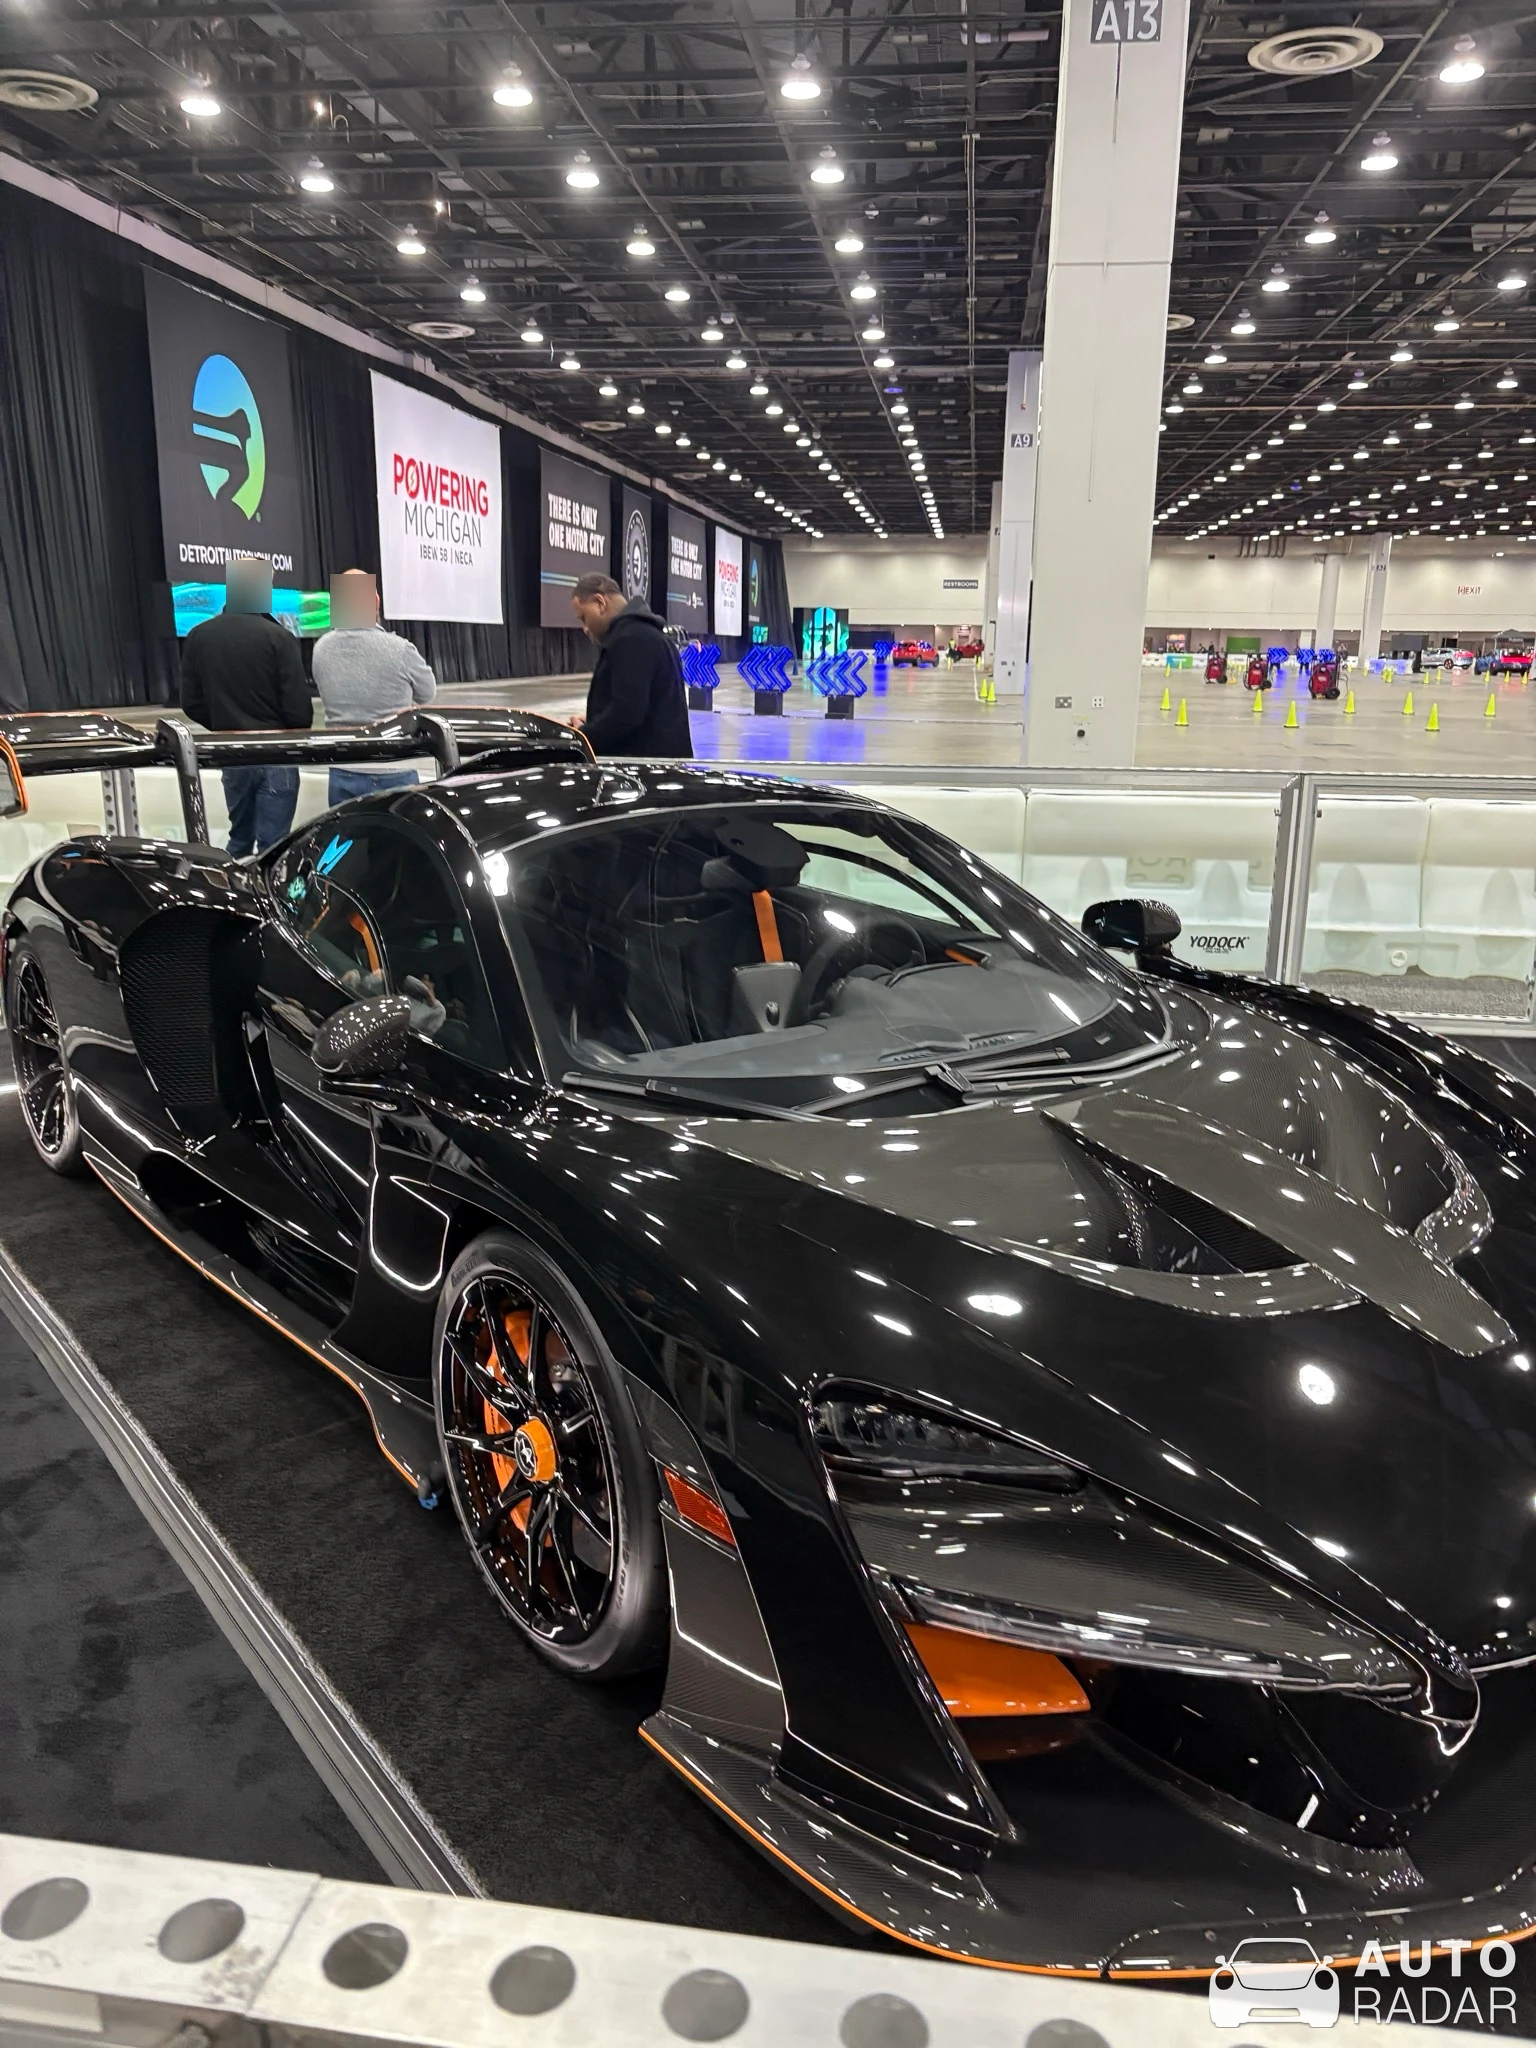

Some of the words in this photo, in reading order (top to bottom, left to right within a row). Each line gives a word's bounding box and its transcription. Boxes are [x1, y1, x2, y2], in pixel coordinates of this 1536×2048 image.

[1094, 0, 1158, 40] A13
[1014, 434, 1031, 447] A9
[393, 453, 489, 517] POWERING
[404, 500, 482, 548] MICHIGAN
[548, 492, 572, 524] THERE
[572, 501, 580, 527] IS
[581, 504, 598, 531] ONLY
[420, 544, 438, 561] IBEW
[440, 547, 448, 562] 58
[454, 550, 473, 566] NECA
[549, 521, 565, 549] ONE
[565, 526, 589, 554] MOTOR
[589, 532, 606, 557] CITY
[1465, 586, 1481, 595] EXIT
[1190, 935, 1245, 949] YODOCK
